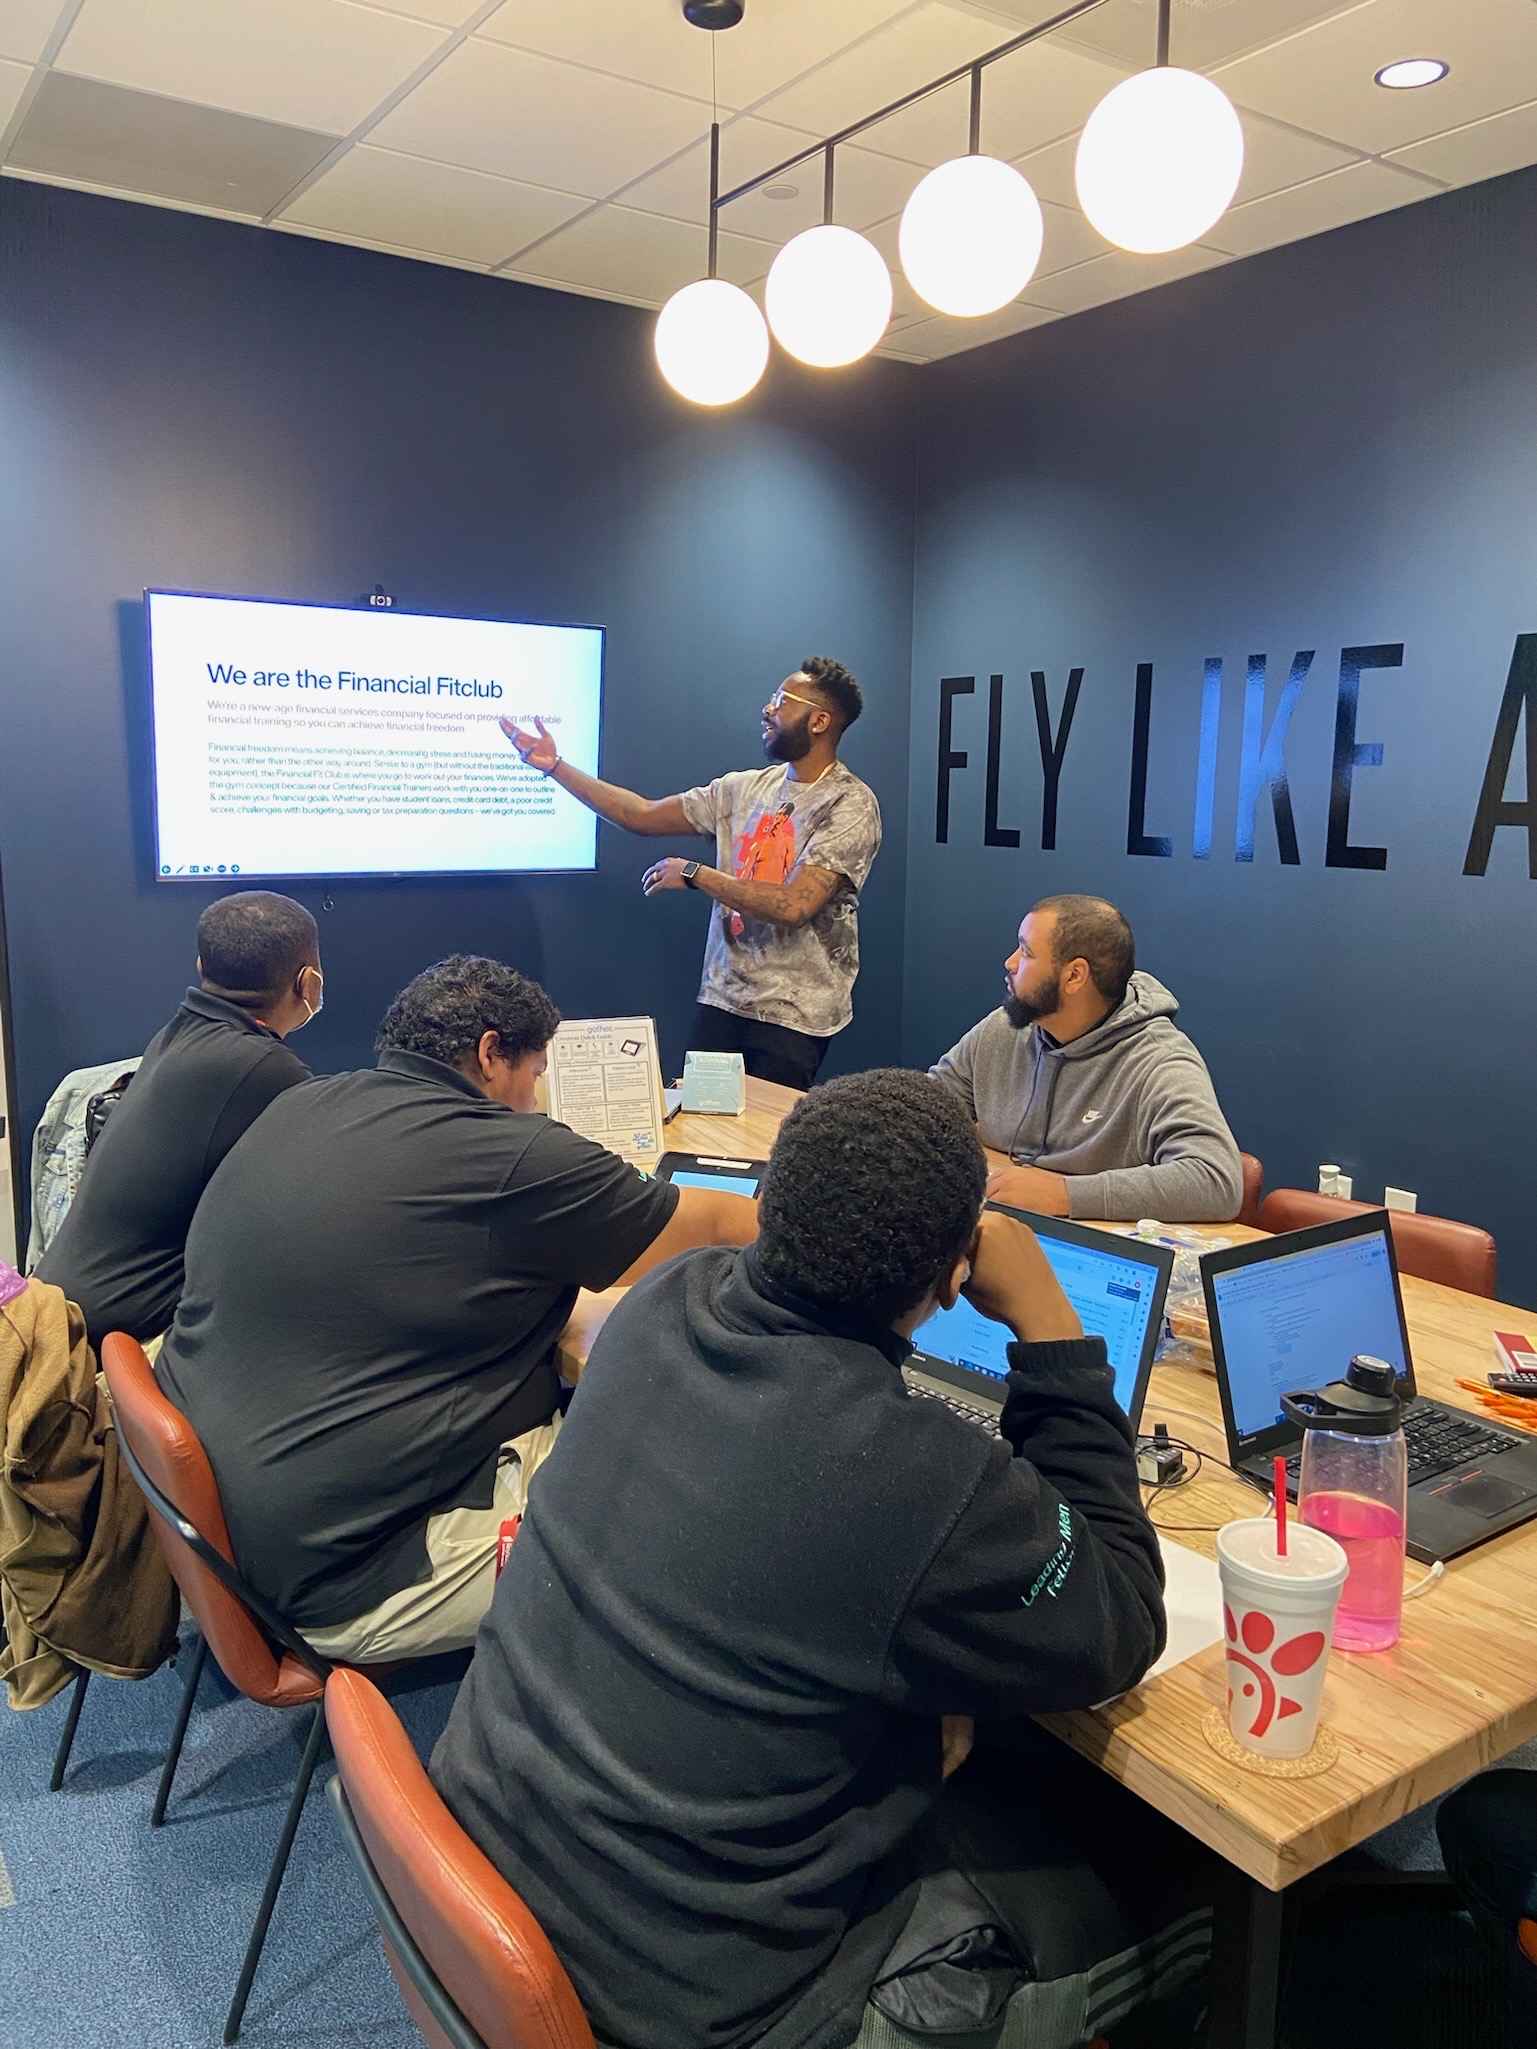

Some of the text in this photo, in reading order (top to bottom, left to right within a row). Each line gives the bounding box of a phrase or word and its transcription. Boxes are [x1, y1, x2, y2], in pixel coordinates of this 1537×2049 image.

[206, 663, 503, 698] We are the Financial Fitclub
[295, 704, 336, 714] financial
[338, 705, 379, 716] services
[380, 710, 424, 720] company
[425, 709, 462, 720] focused
[207, 713, 252, 724] financial
[253, 715, 291, 728] training
[347, 719, 385, 729] achieve
[385, 720, 425, 731] financial
[936, 632, 1537, 881] FLY LIKE A
[448, 761, 474, 769] without
[413, 772, 432, 780] work
[245, 781, 280, 791] concept
[367, 783, 401, 791] Financial
[271, 793, 305, 801] financial
[381, 794, 400, 802] have
[345, 806, 371, 817] saving
